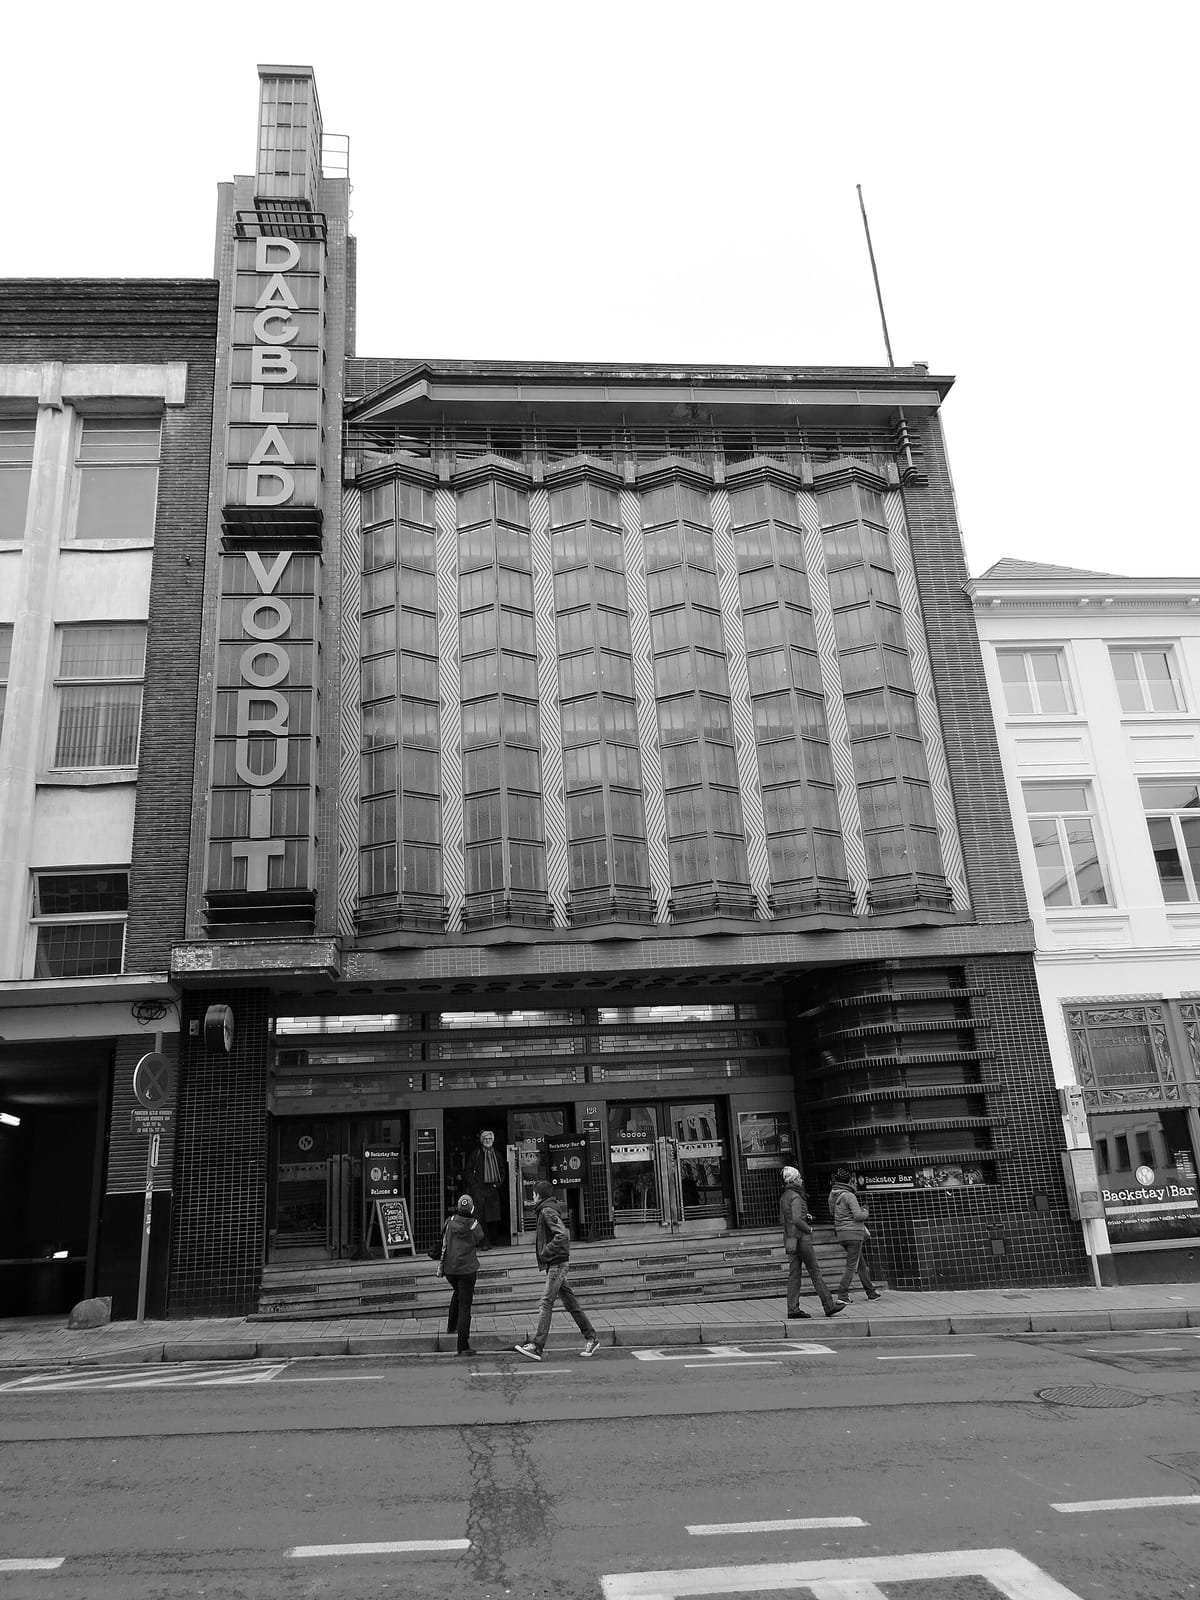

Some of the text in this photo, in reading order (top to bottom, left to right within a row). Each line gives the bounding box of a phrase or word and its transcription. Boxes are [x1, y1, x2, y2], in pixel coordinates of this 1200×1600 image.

[231, 236, 301, 892] DAGBLAD VOORUIT
[865, 1174, 913, 1184] Backstay Bar
[1101, 1185, 1195, 1202] Backstay Bar
